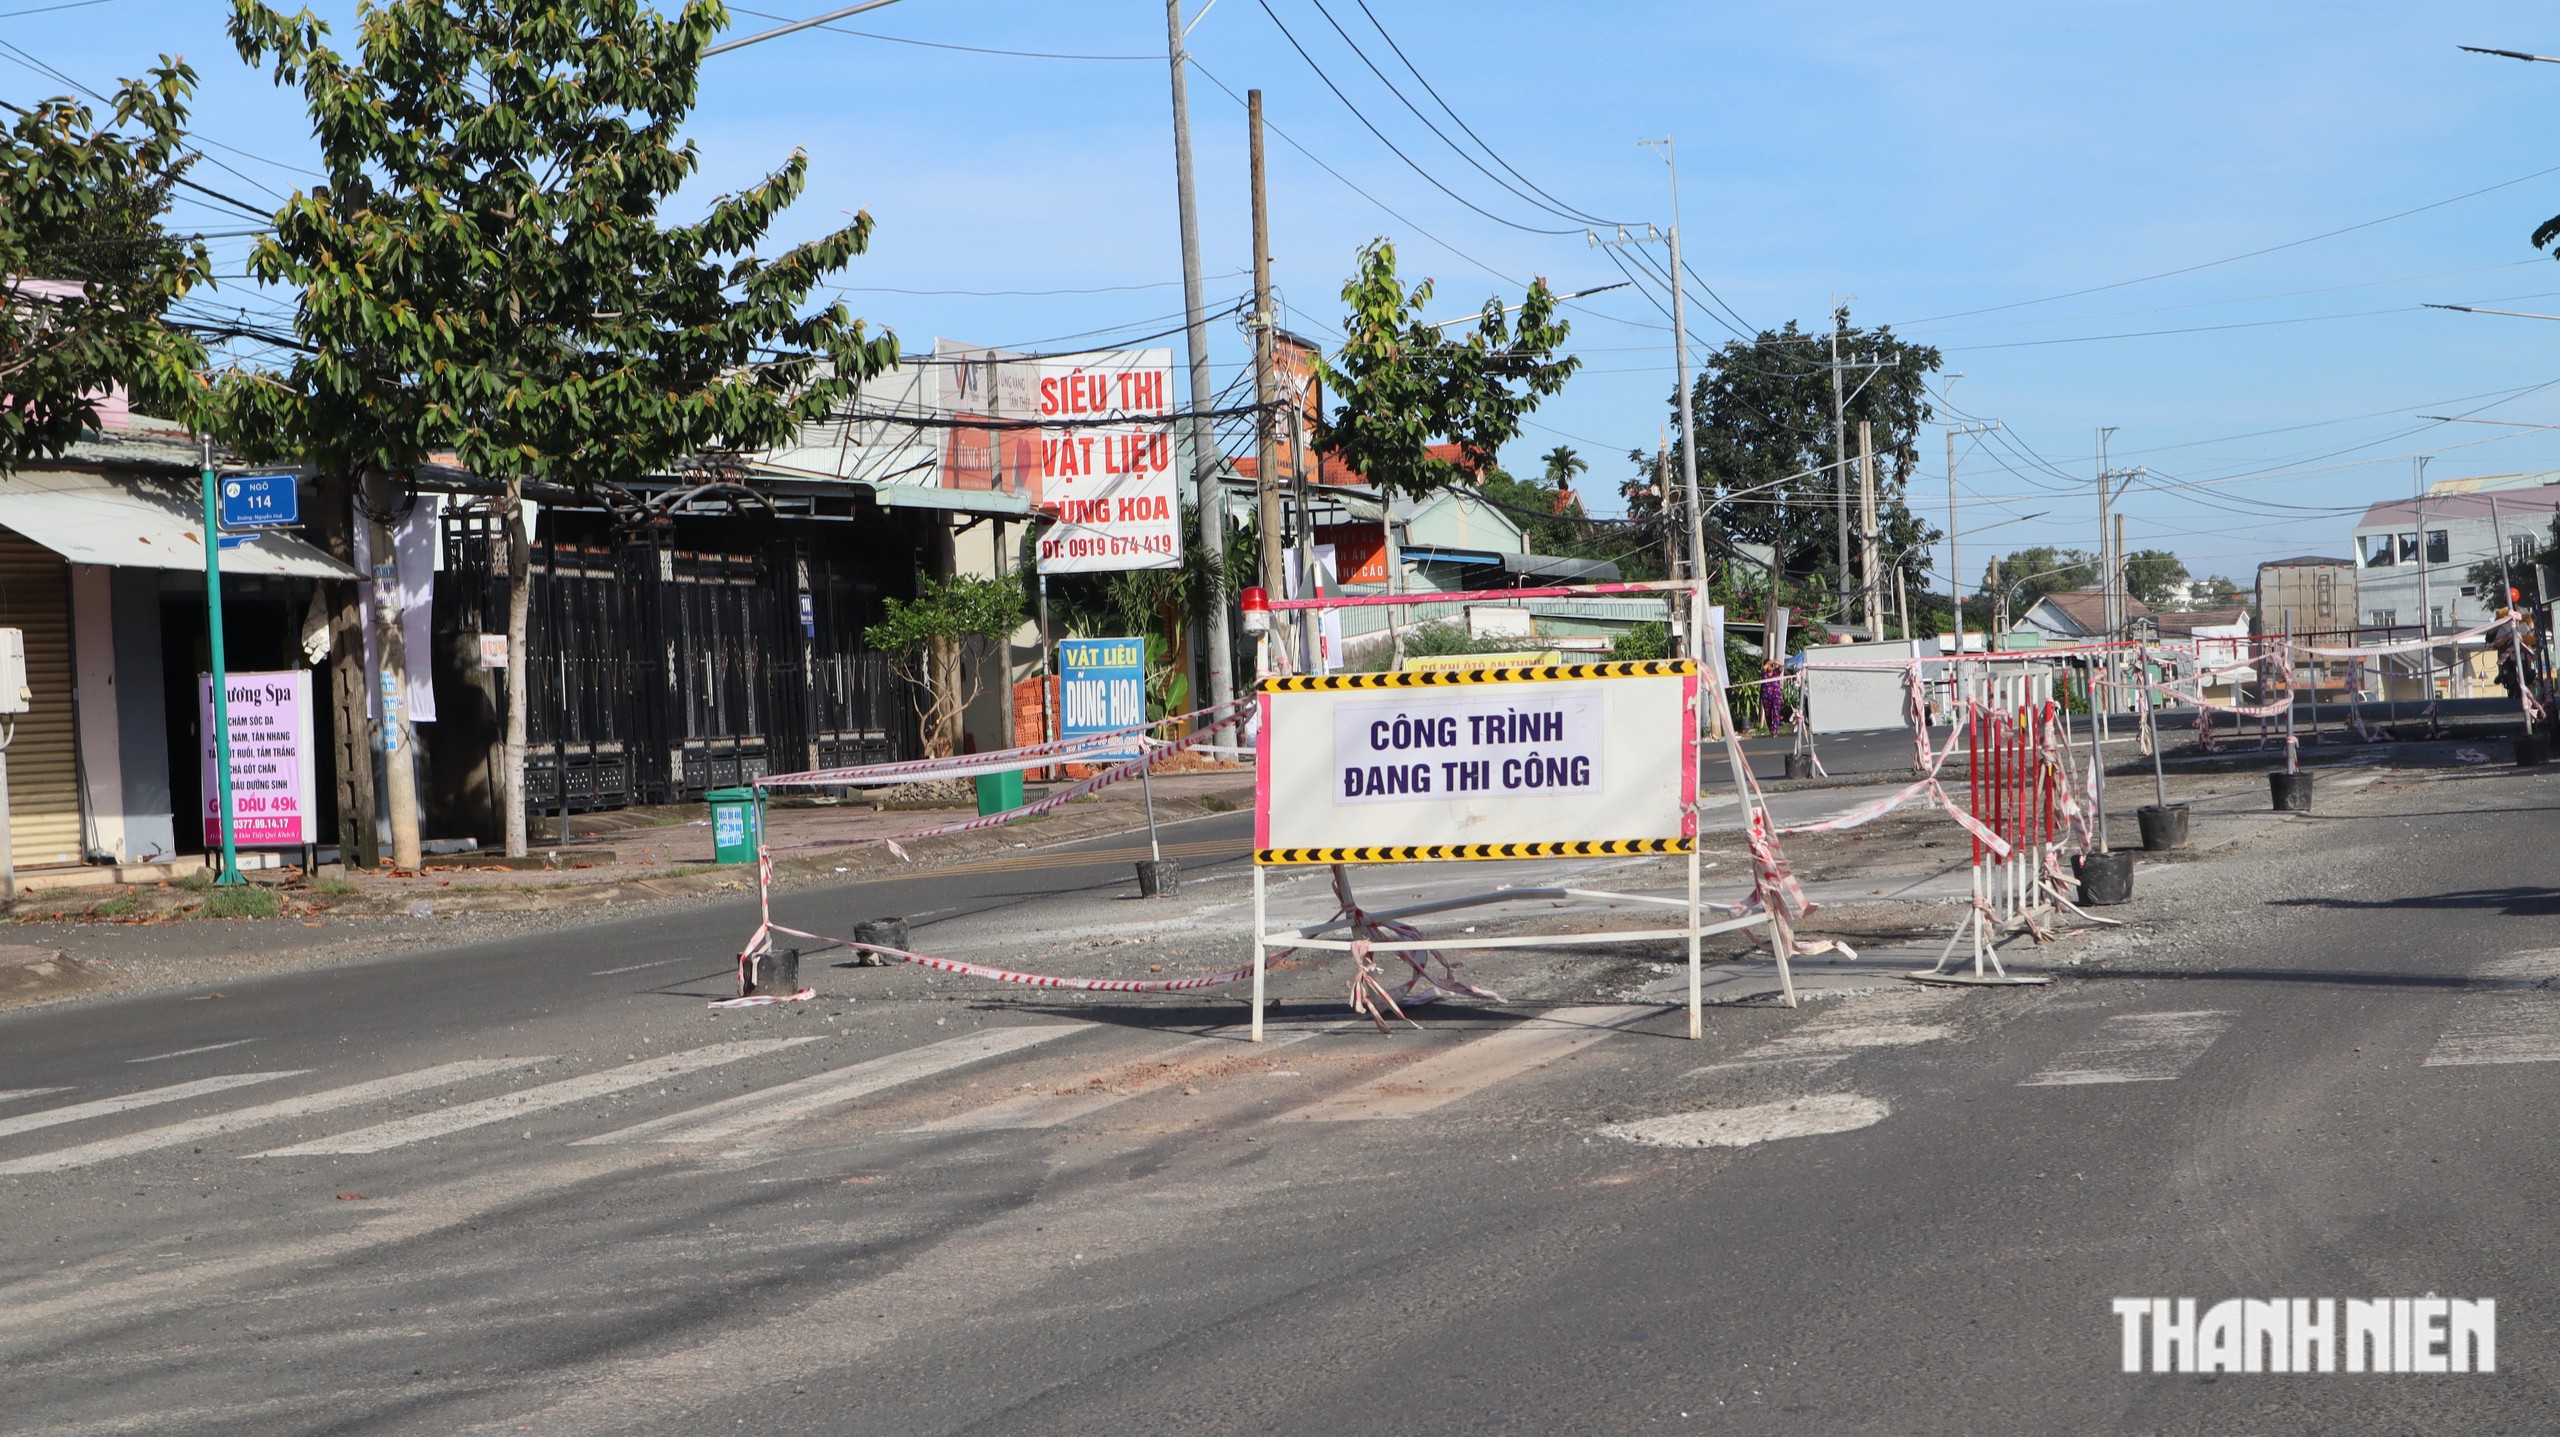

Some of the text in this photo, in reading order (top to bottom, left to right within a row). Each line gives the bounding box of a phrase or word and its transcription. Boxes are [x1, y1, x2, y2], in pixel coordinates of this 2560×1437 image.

[1041, 367, 1164, 418] SIÊU THỊ
[1042, 425, 1169, 484] VẬT LIỆU
[247, 495, 272, 509] 114
[1118, 495, 1170, 522] HOA
[1042, 534, 1172, 559] ĐT: 0919 674 419
[1361, 563, 1384, 577] CÁO
[1066, 644, 1138, 670] VẬT LIỆU
[265, 683, 292, 707] Spa
[1066, 671, 1140, 728] DŨNG HOA
[249, 715, 263, 726] SÓC
[264, 715, 274, 726] DA
[1370, 707, 1563, 751] CÔNG TRÌNH
[266, 731, 290, 741] NHANG
[271, 780, 288, 789] SINH
[1344, 751, 1590, 797] ĐANG THI CÔNG
[271, 797, 298, 811] 49k
